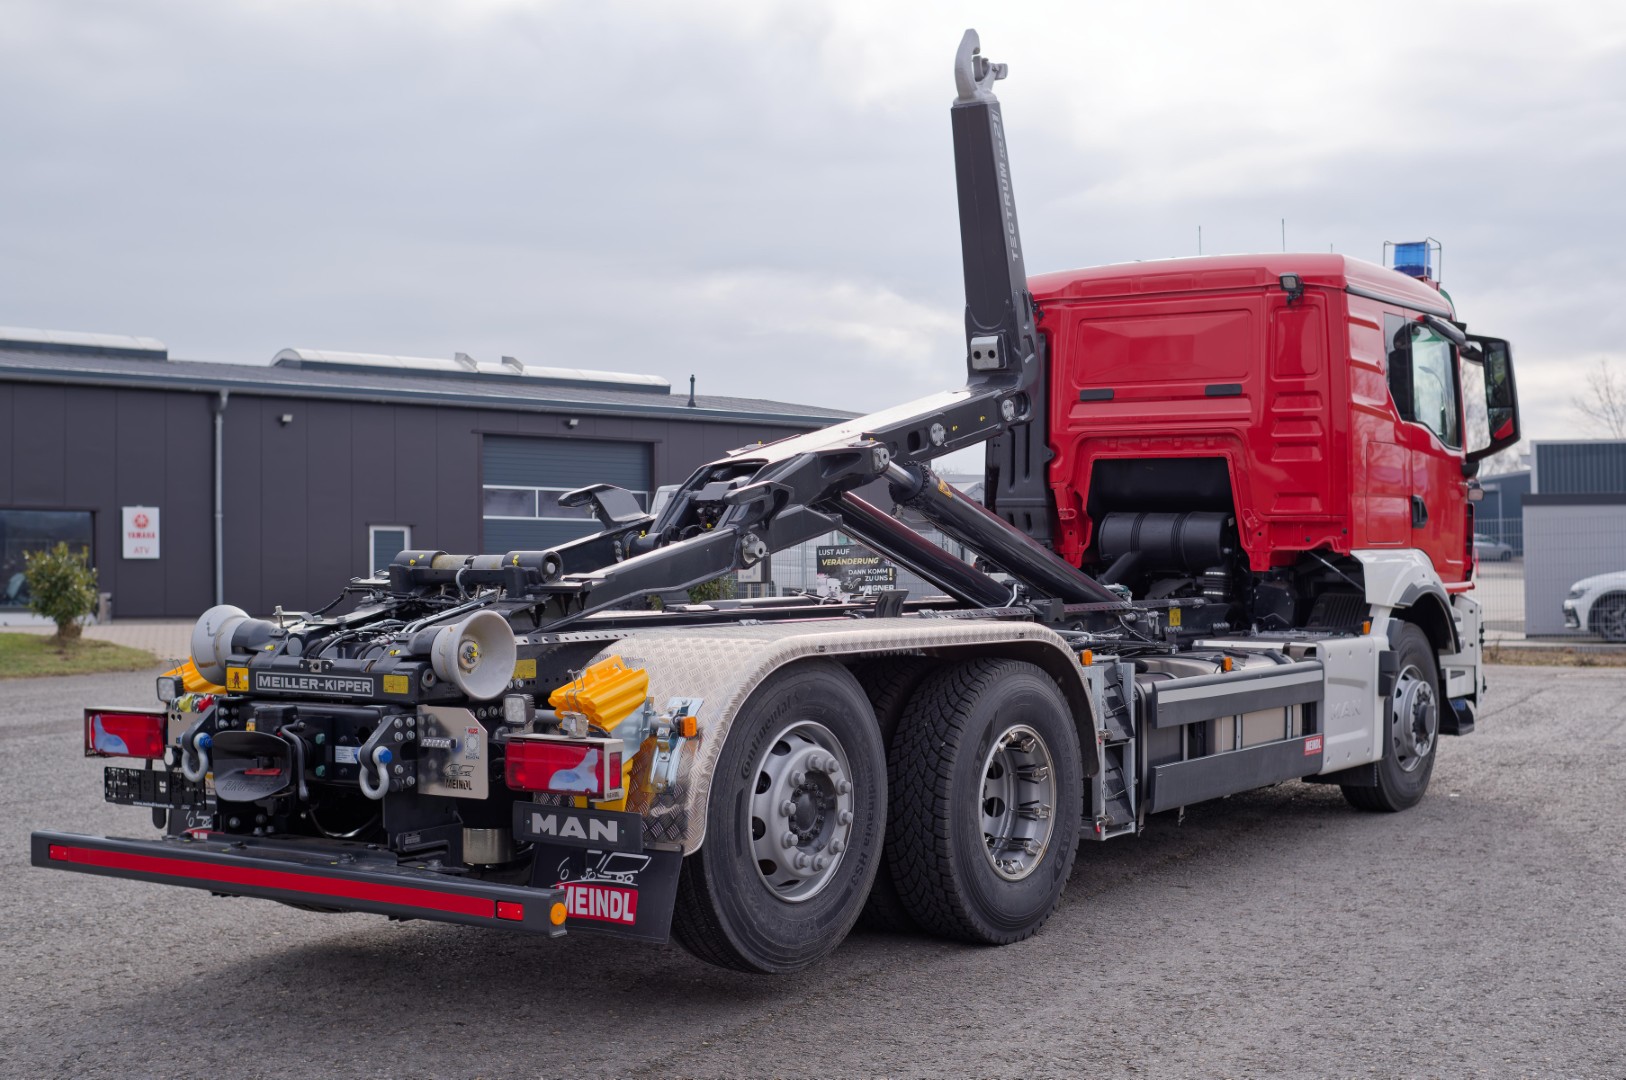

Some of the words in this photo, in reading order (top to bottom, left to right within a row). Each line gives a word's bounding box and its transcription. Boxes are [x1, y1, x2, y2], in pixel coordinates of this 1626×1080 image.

[999, 161, 1019, 262] TECTRUM
[821, 557, 879, 566] VERÄNDERUNG
[858, 584, 895, 597] WAGNER
[258, 675, 371, 693] MEILLER-KIPPER
[445, 779, 472, 791] MEINDL
[531, 812, 618, 842] MAN
